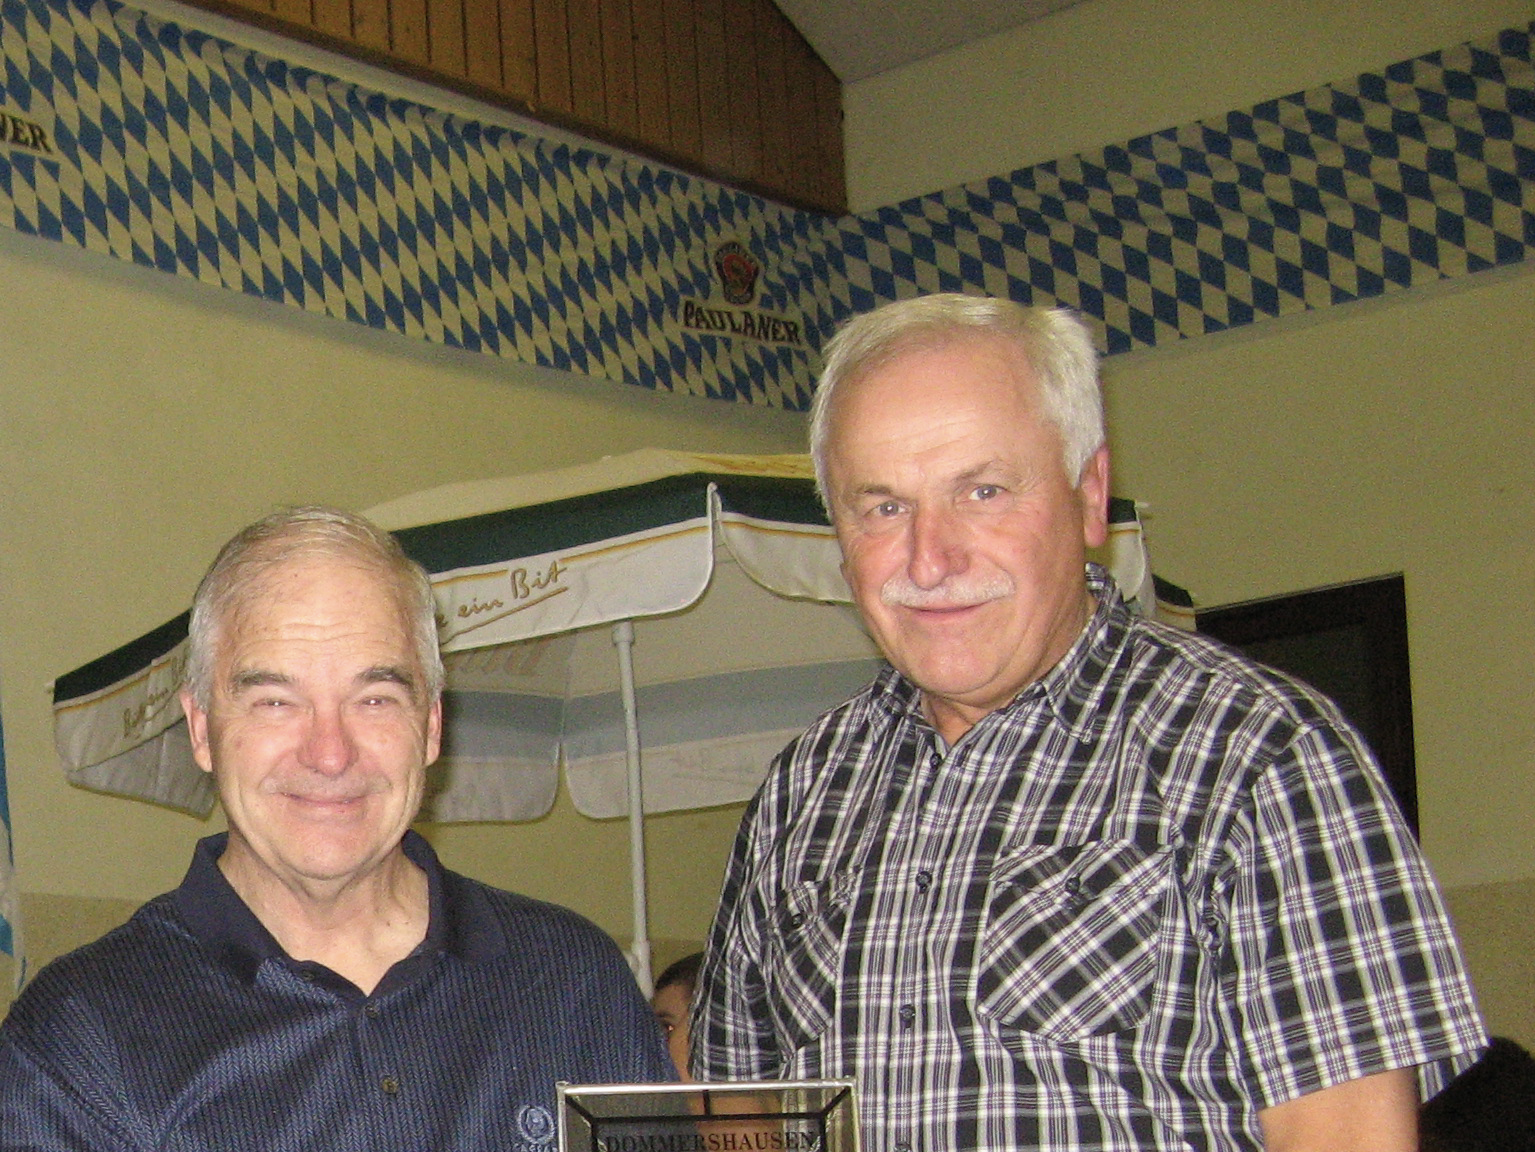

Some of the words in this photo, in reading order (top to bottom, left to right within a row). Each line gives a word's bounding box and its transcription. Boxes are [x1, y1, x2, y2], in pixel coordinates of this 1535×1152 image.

[684, 300, 800, 344] PAULANER
[458, 597, 503, 618] ein
[511, 560, 567, 600] Bit
